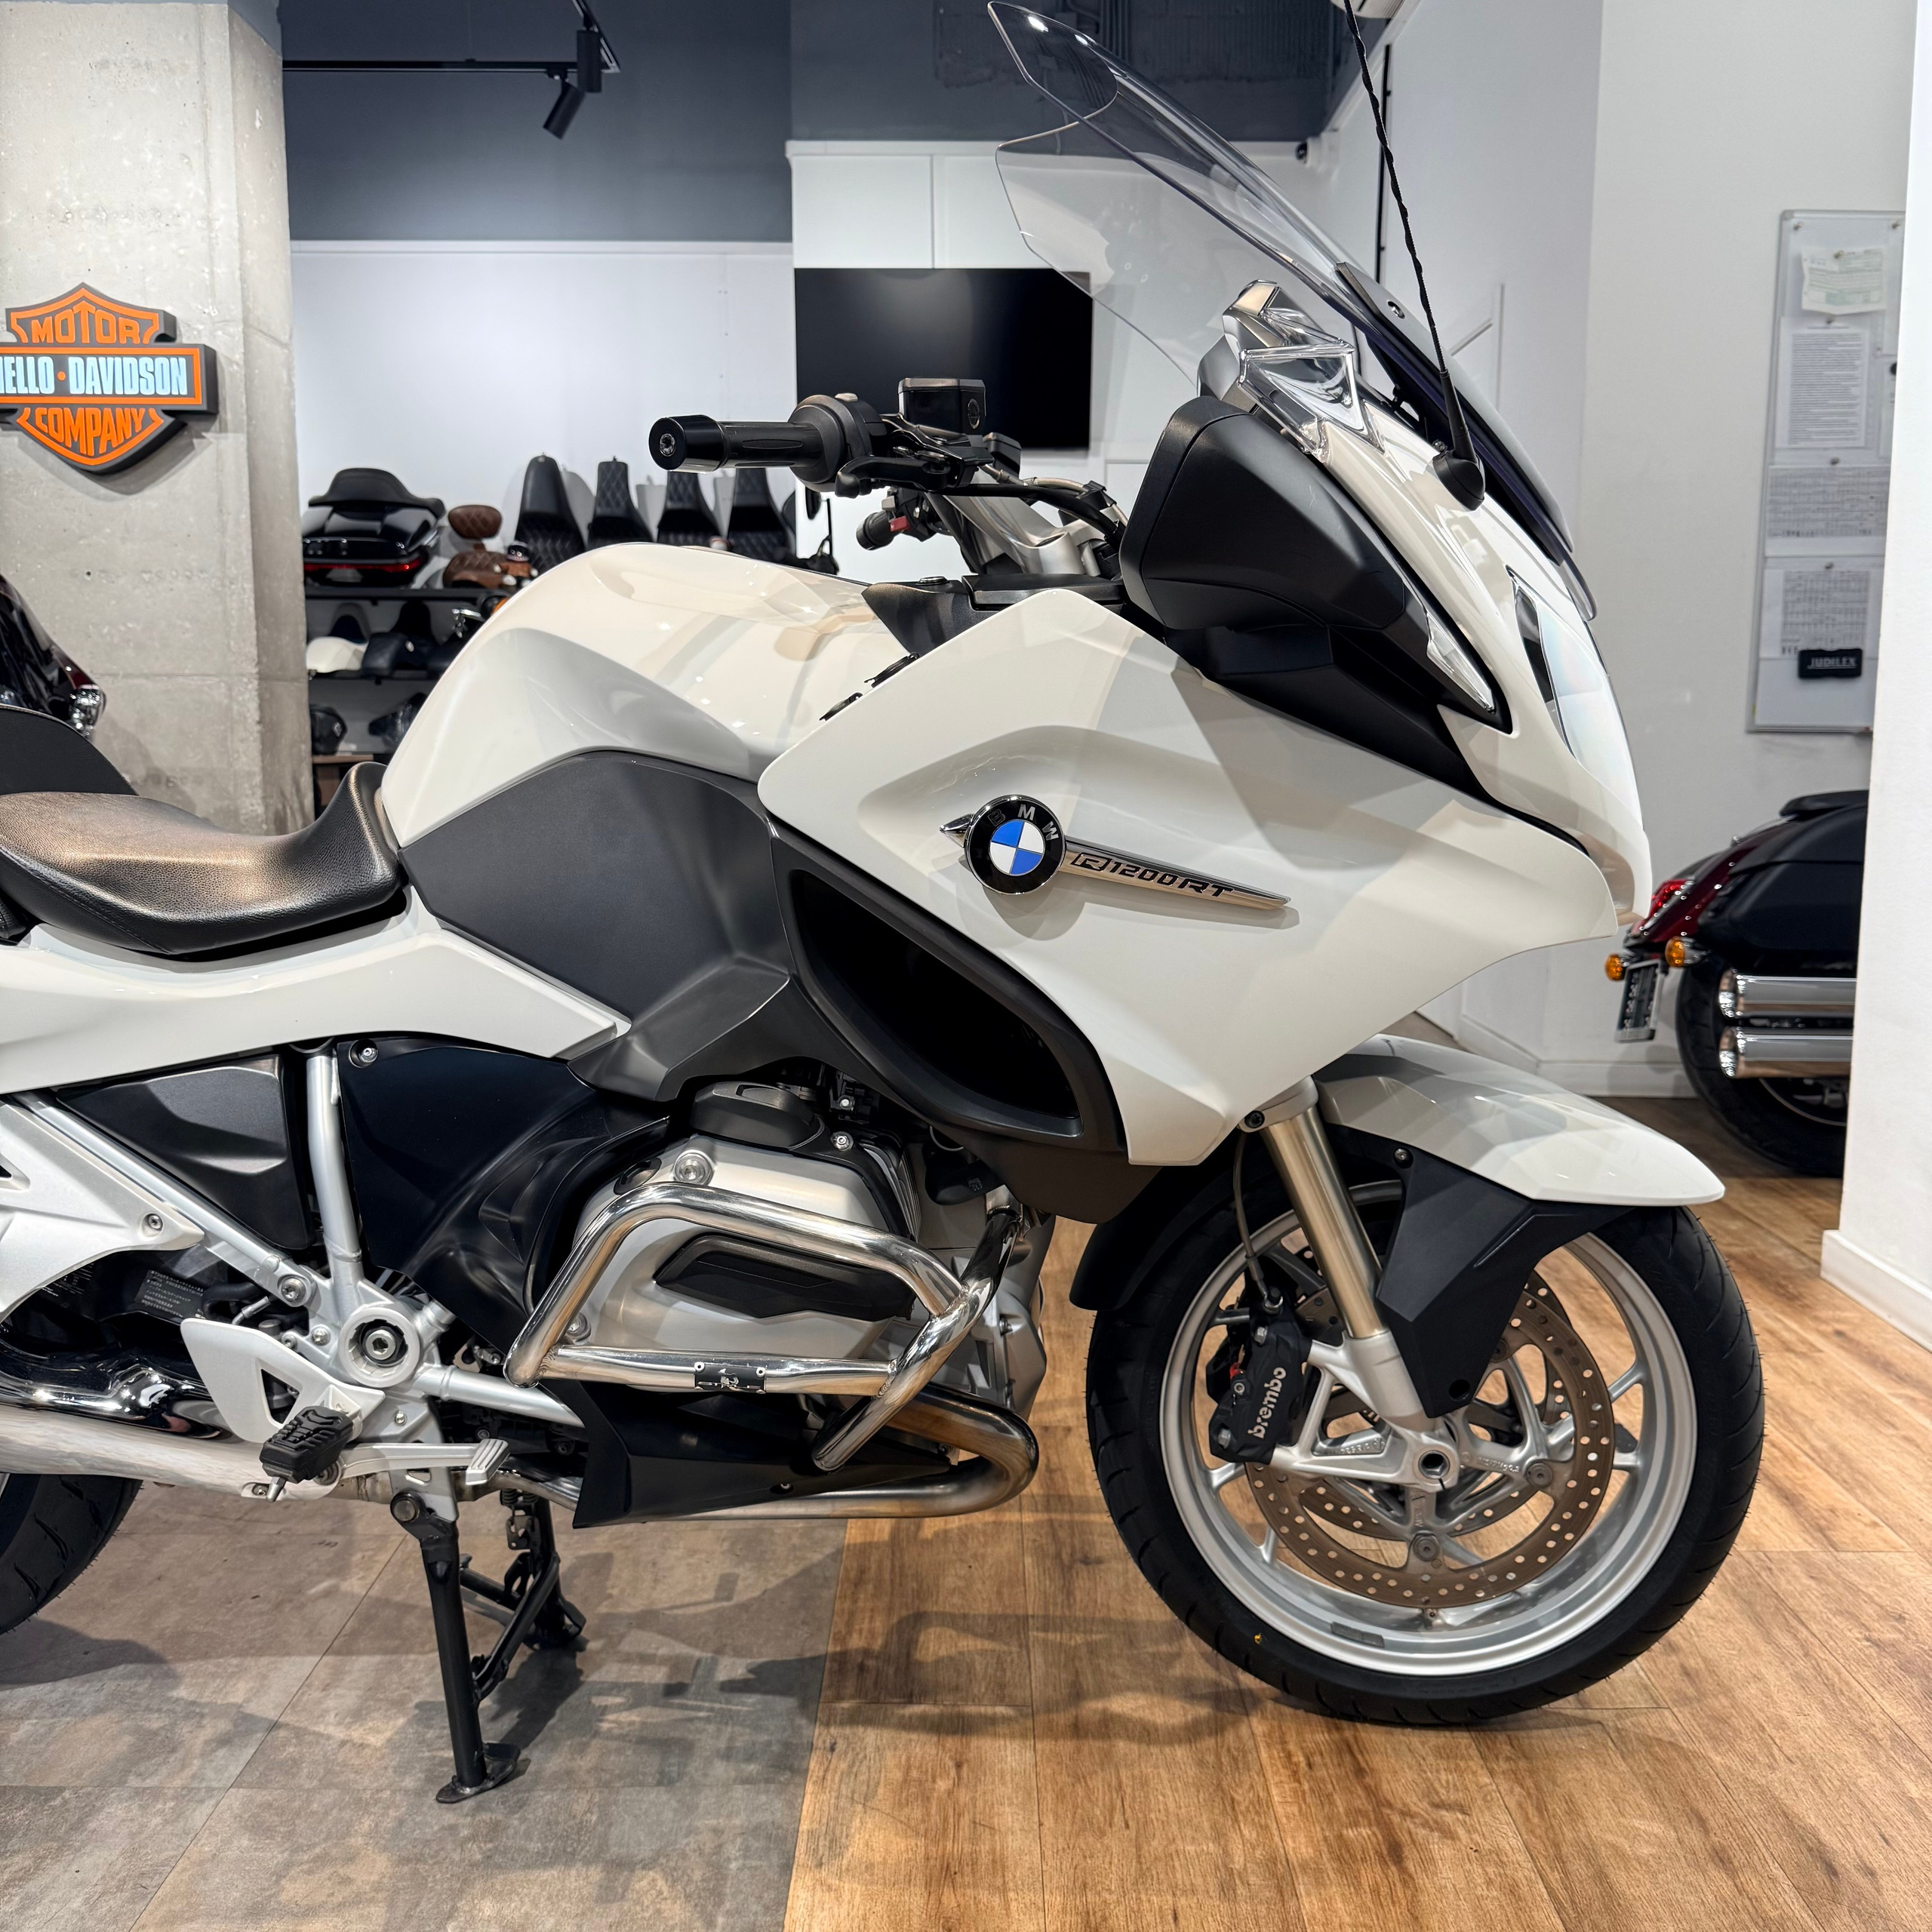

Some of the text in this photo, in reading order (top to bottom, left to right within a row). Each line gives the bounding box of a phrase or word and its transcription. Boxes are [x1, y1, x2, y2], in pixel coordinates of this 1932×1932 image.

[31, 300, 140, 344] MOTOR
[0, 355, 187, 395] ELLO DAVIDSON
[35, 408, 145, 457] COMPANY
[987, 804, 1059, 841] BMW
[1247, 1367, 1287, 1439] brembo
